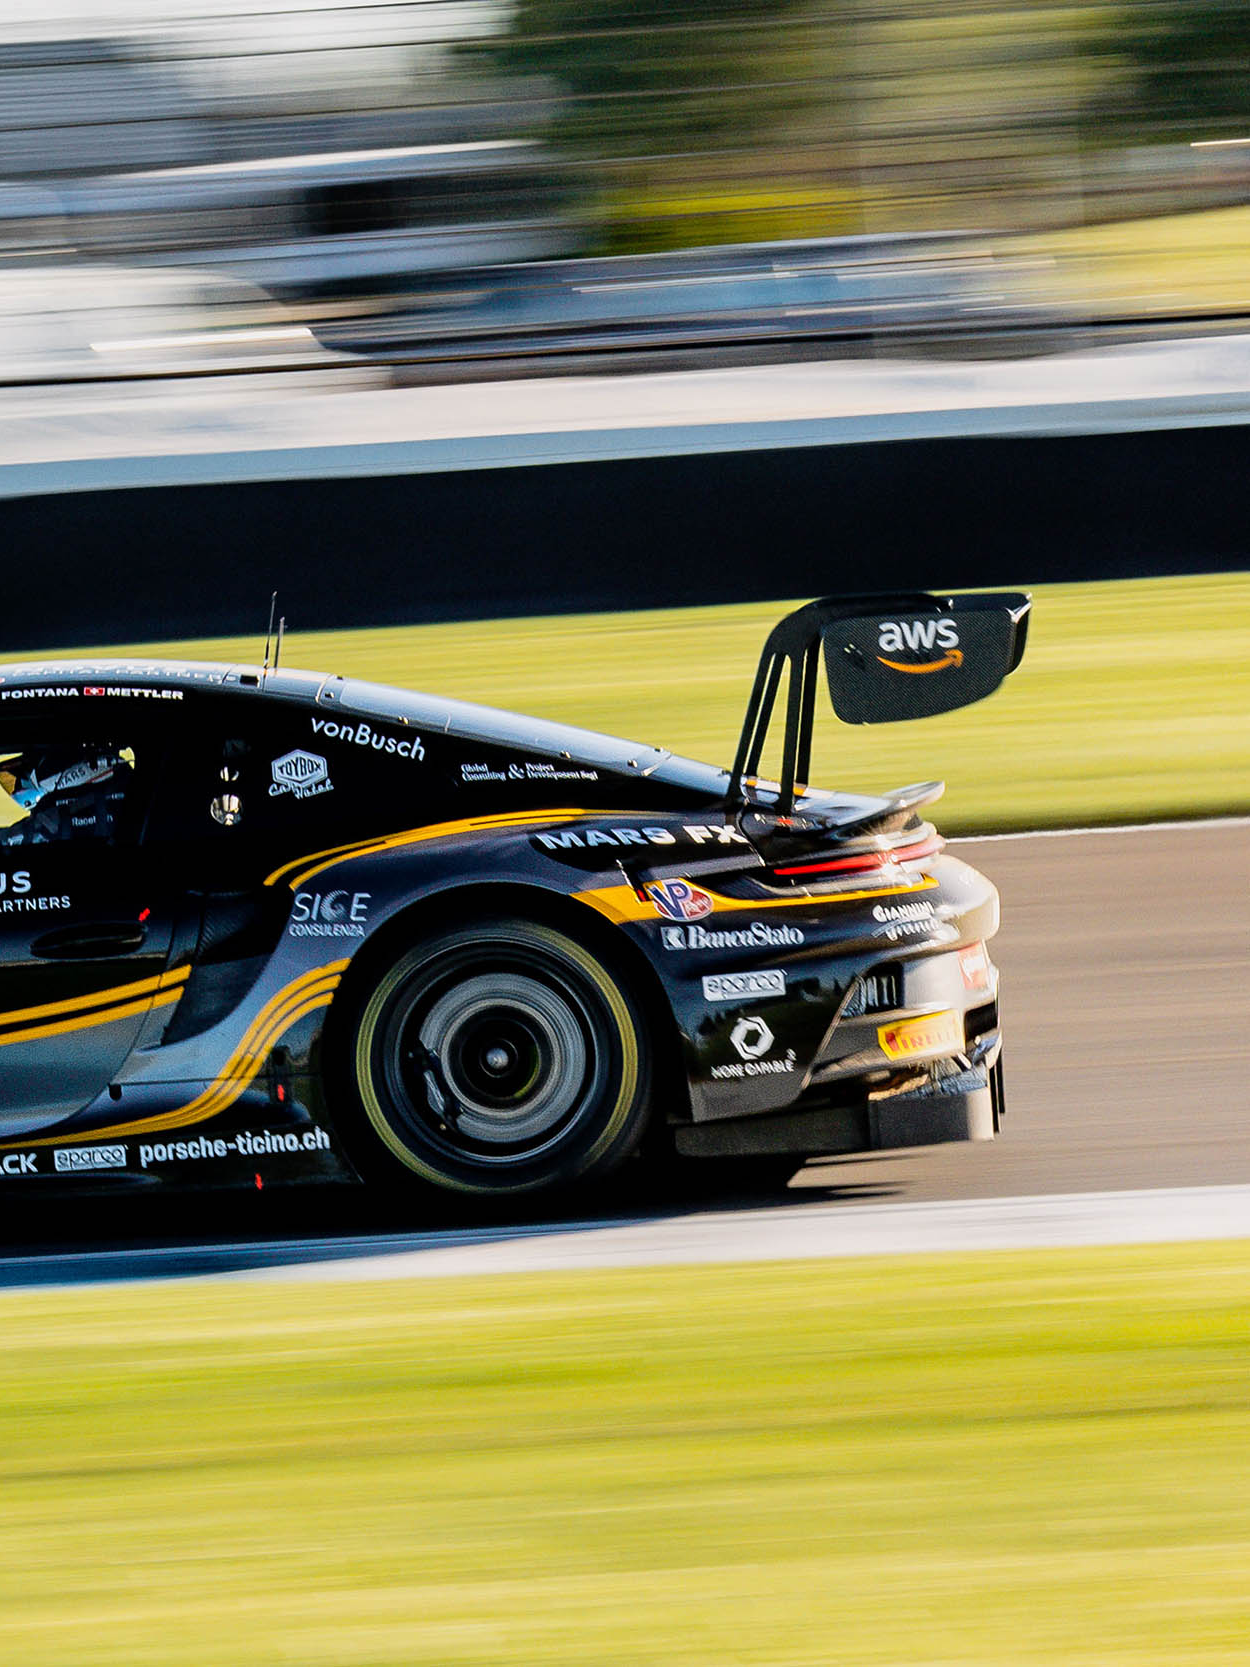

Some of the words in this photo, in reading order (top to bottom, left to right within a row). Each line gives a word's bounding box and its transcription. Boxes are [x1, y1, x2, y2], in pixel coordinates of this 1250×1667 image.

[878, 618, 959, 652] aws
[1, 687, 79, 700] FONTANA
[106, 687, 183, 700] METTLER
[311, 717, 426, 761] vonBusch
[277, 757, 322, 777] TOYBOX
[535, 827, 676, 850] MARS
[682, 825, 750, 844] FX
[649, 880, 690, 919] VP
[687, 921, 805, 949] BancaStato
[139, 1125, 330, 1168] porsche-ticino.ch
